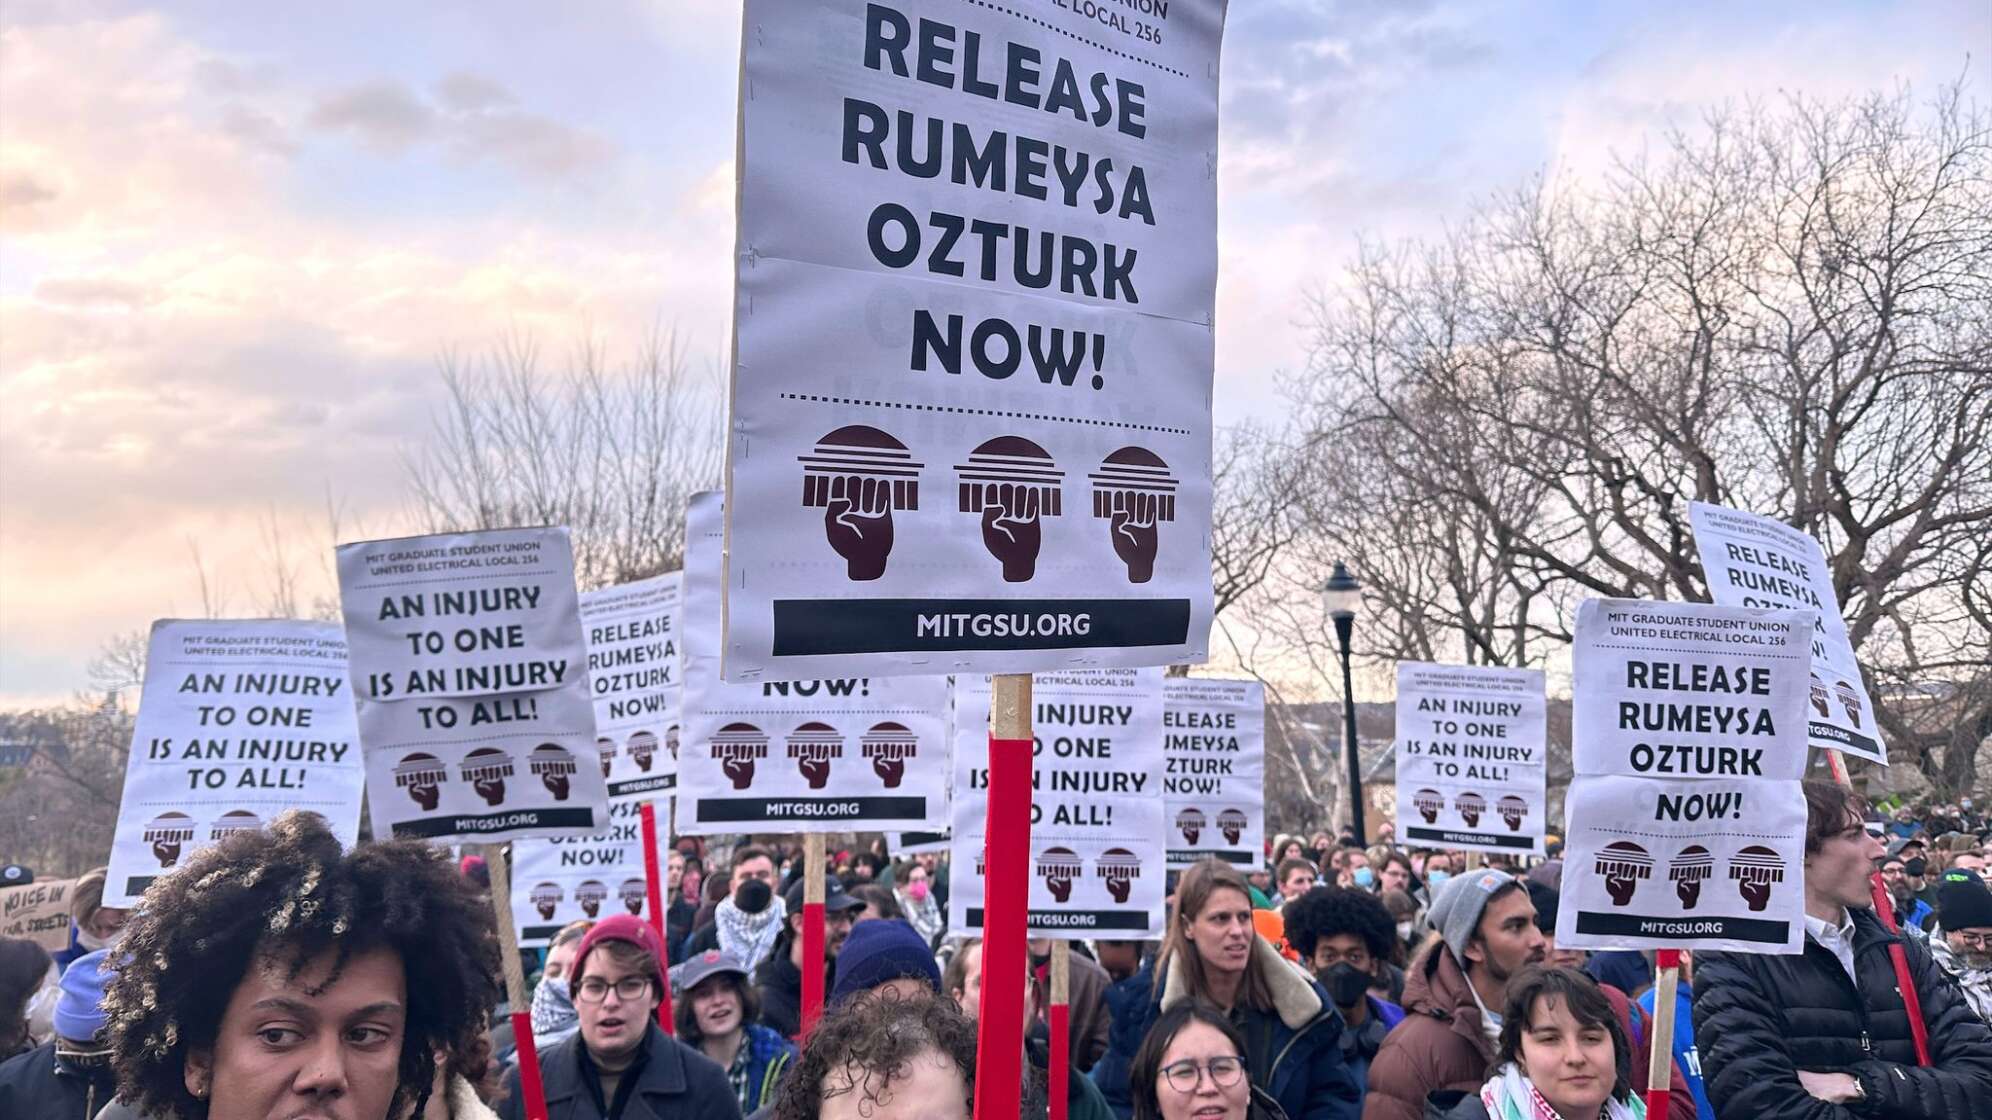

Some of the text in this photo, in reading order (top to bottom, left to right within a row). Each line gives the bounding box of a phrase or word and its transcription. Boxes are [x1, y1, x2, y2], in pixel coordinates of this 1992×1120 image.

[1073, 0, 1162, 45] LOCAL 256
[864, 3, 1147, 140] RELEASE
[841, 97, 1156, 226] RUMEYSA
[866, 202, 1140, 304] OZTURK
[910, 309, 1106, 390] NOW!
[366, 541, 541, 564] MIT GRADUATE STUDENT UNION
[1725, 542, 1811, 582] RELEASE
[371, 554, 539, 576] UNITED ELECTRICAL LOCAL 256
[1727, 567, 1823, 610] RUMEYSA
[378, 586, 541, 620] AN INJURY
[591, 615, 671, 645] RELEASE
[917, 613, 1090, 638] MITGSU.ORG
[1608, 613, 1790, 633] MIT GRADUATE STUDENT UNION
[183, 636, 346, 649] MIT GRADUATE STUDENT UNIO
[407, 625, 525, 655] TO ONE
[1610, 627, 1786, 646] UNITED ELECTRICAL LOCAL 256
[184, 647, 226, 655] UNITED
[228, 647, 289, 656] ELECTRICAL
[292, 649, 329, 659] LOCAL
[588, 639, 675, 670] RUMEYSA
[179, 673, 342, 697] AN INJURY
[370, 660, 567, 697] IS AN INJURY
[594, 666, 670, 694] OZTURK
[1085, 678, 1118, 687] LOCAL
[1119, 678, 1135, 687] 256
[1627, 661, 1771, 696] RELEASE
[198, 706, 313, 727] TO ONE
[418, 698, 538, 729] TO ALL!
[610, 694, 666, 719] NOW!
[1038, 703, 1132, 727] INJURY
[1417, 698, 1522, 717] AN INJURY
[1164, 711, 1236, 729] ELEASE
[1432, 720, 1507, 738] TO ONE
[1619, 702, 1776, 736] RUMEYSA
[148, 738, 348, 762] IS AN INJURY
[1054, 737, 1111, 758] ONE
[1407, 740, 1532, 761] IS AN INJURY
[1166, 757, 1232, 775] ZTURK
[1433, 762, 1508, 781] TO ALL!
[1630, 744, 1763, 776] OZTURK
[187, 769, 306, 789] TO ALL!
[1051, 770, 1147, 794] INJURY
[1163, 777, 1222, 795] NOW!
[766, 803, 860, 816] MITGSU.ORG
[1053, 805, 1113, 826] ALL!
[1655, 792, 1743, 821] NOW!
[455, 813, 538, 830] MITGSU.ORG
[561, 849, 624, 867] NOW!
[1640, 921, 1723, 934] MITGSU.ORG
